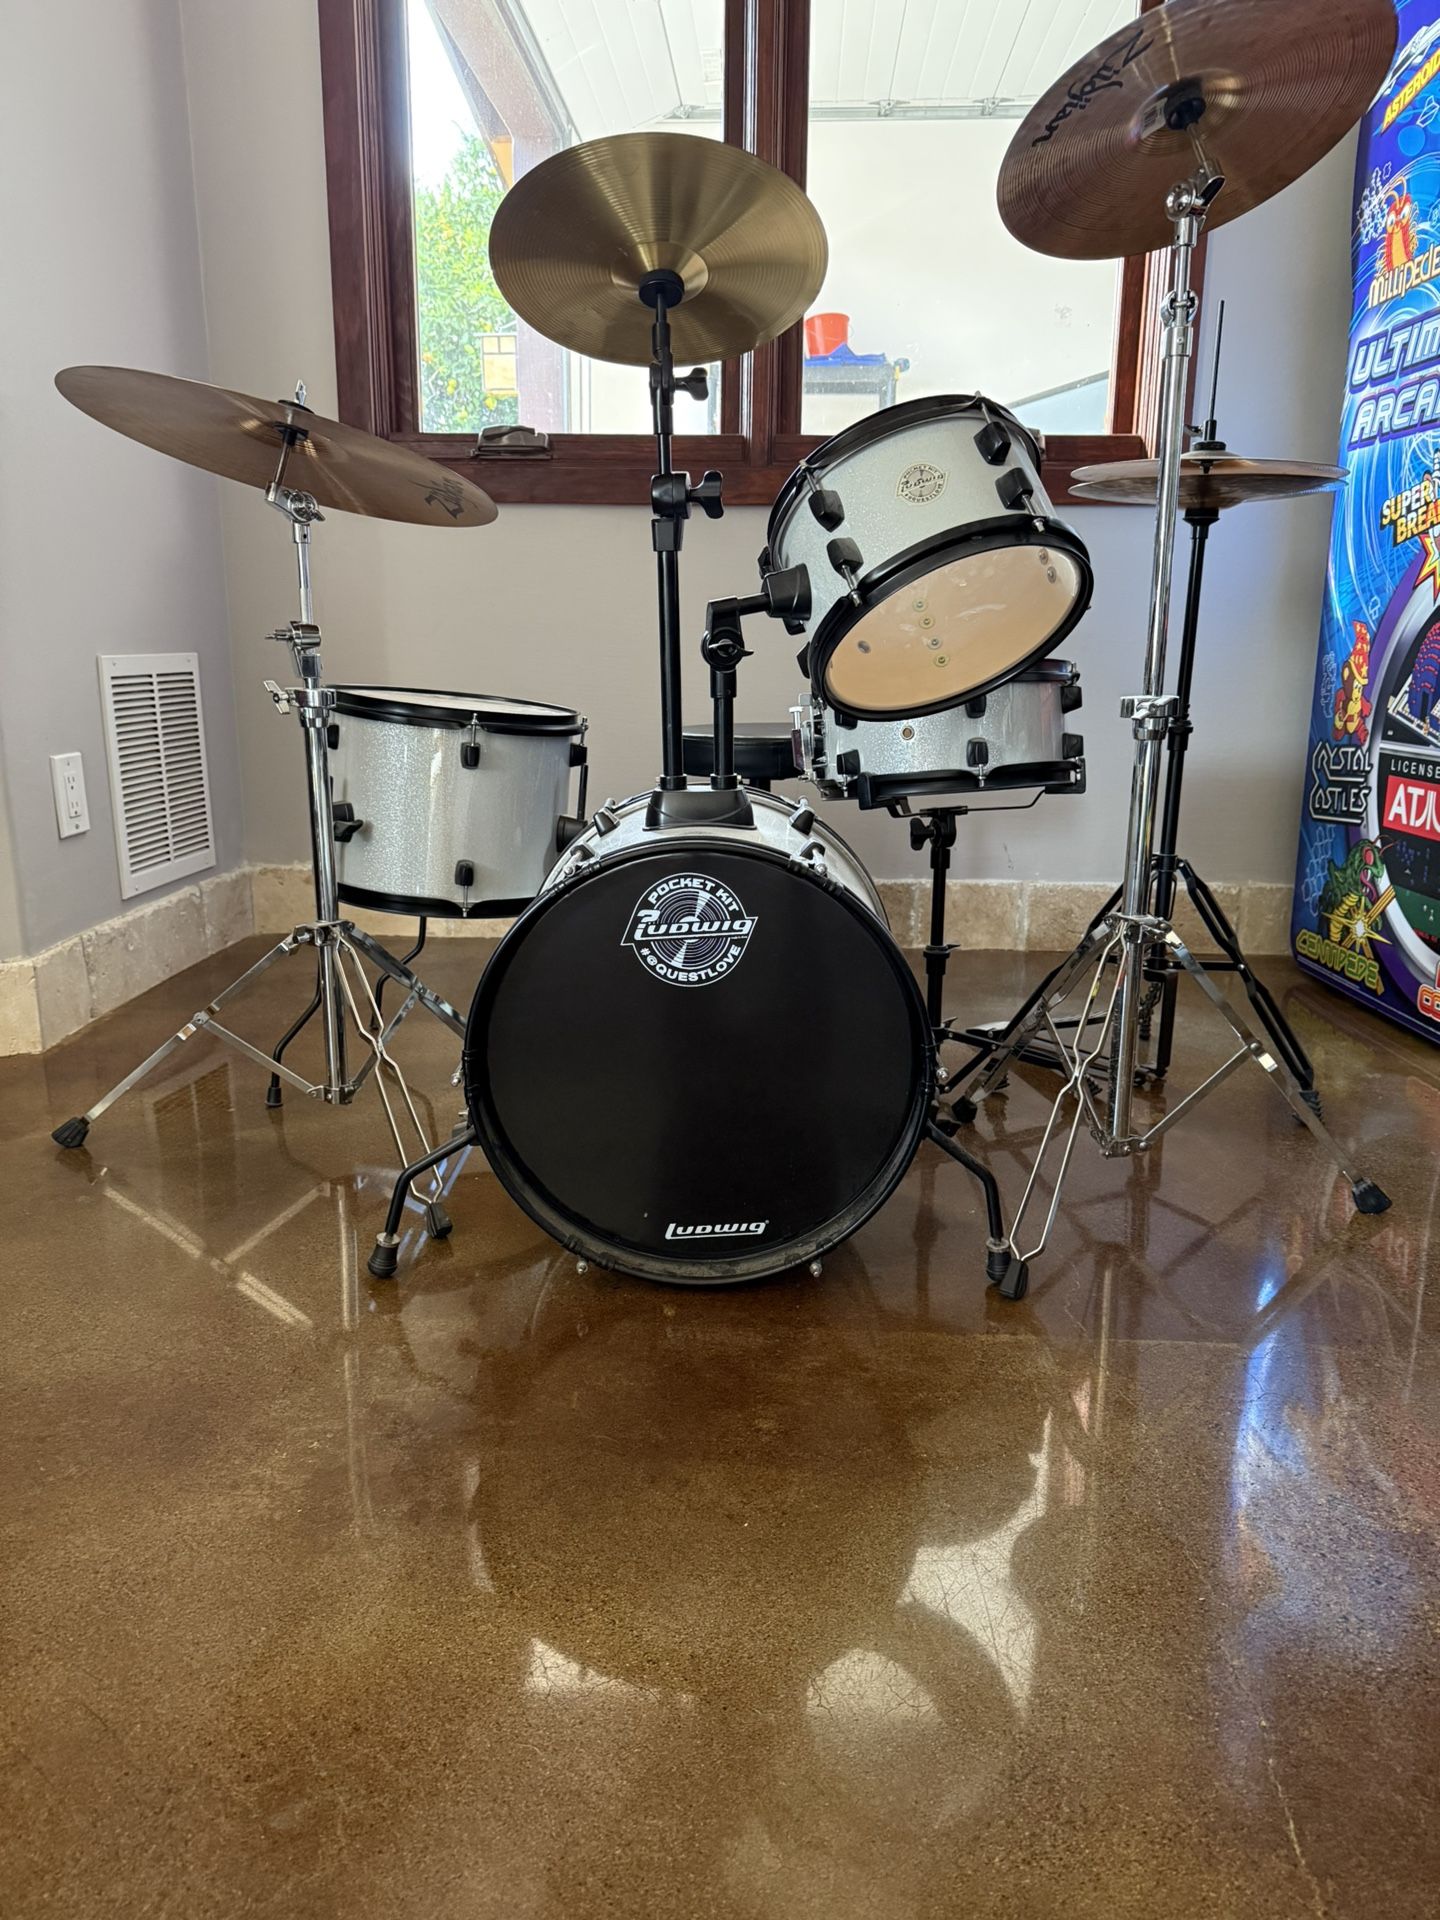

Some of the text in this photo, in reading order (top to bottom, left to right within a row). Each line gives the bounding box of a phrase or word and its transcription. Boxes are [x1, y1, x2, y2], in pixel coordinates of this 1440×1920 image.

[1032, 29, 1154, 147] Zildjian
[1351, 379, 1440, 442] ARCA
[1382, 480, 1434, 525] SUPER
[1312, 742, 1372, 782] CRYSTAL
[1309, 783, 1370, 823] CASTLES
[647, 877, 740, 912] POCKET KIT
[640, 944, 742, 982] #@QUESTLOVE
[1296, 929, 1379, 990] CENTIPEDE
